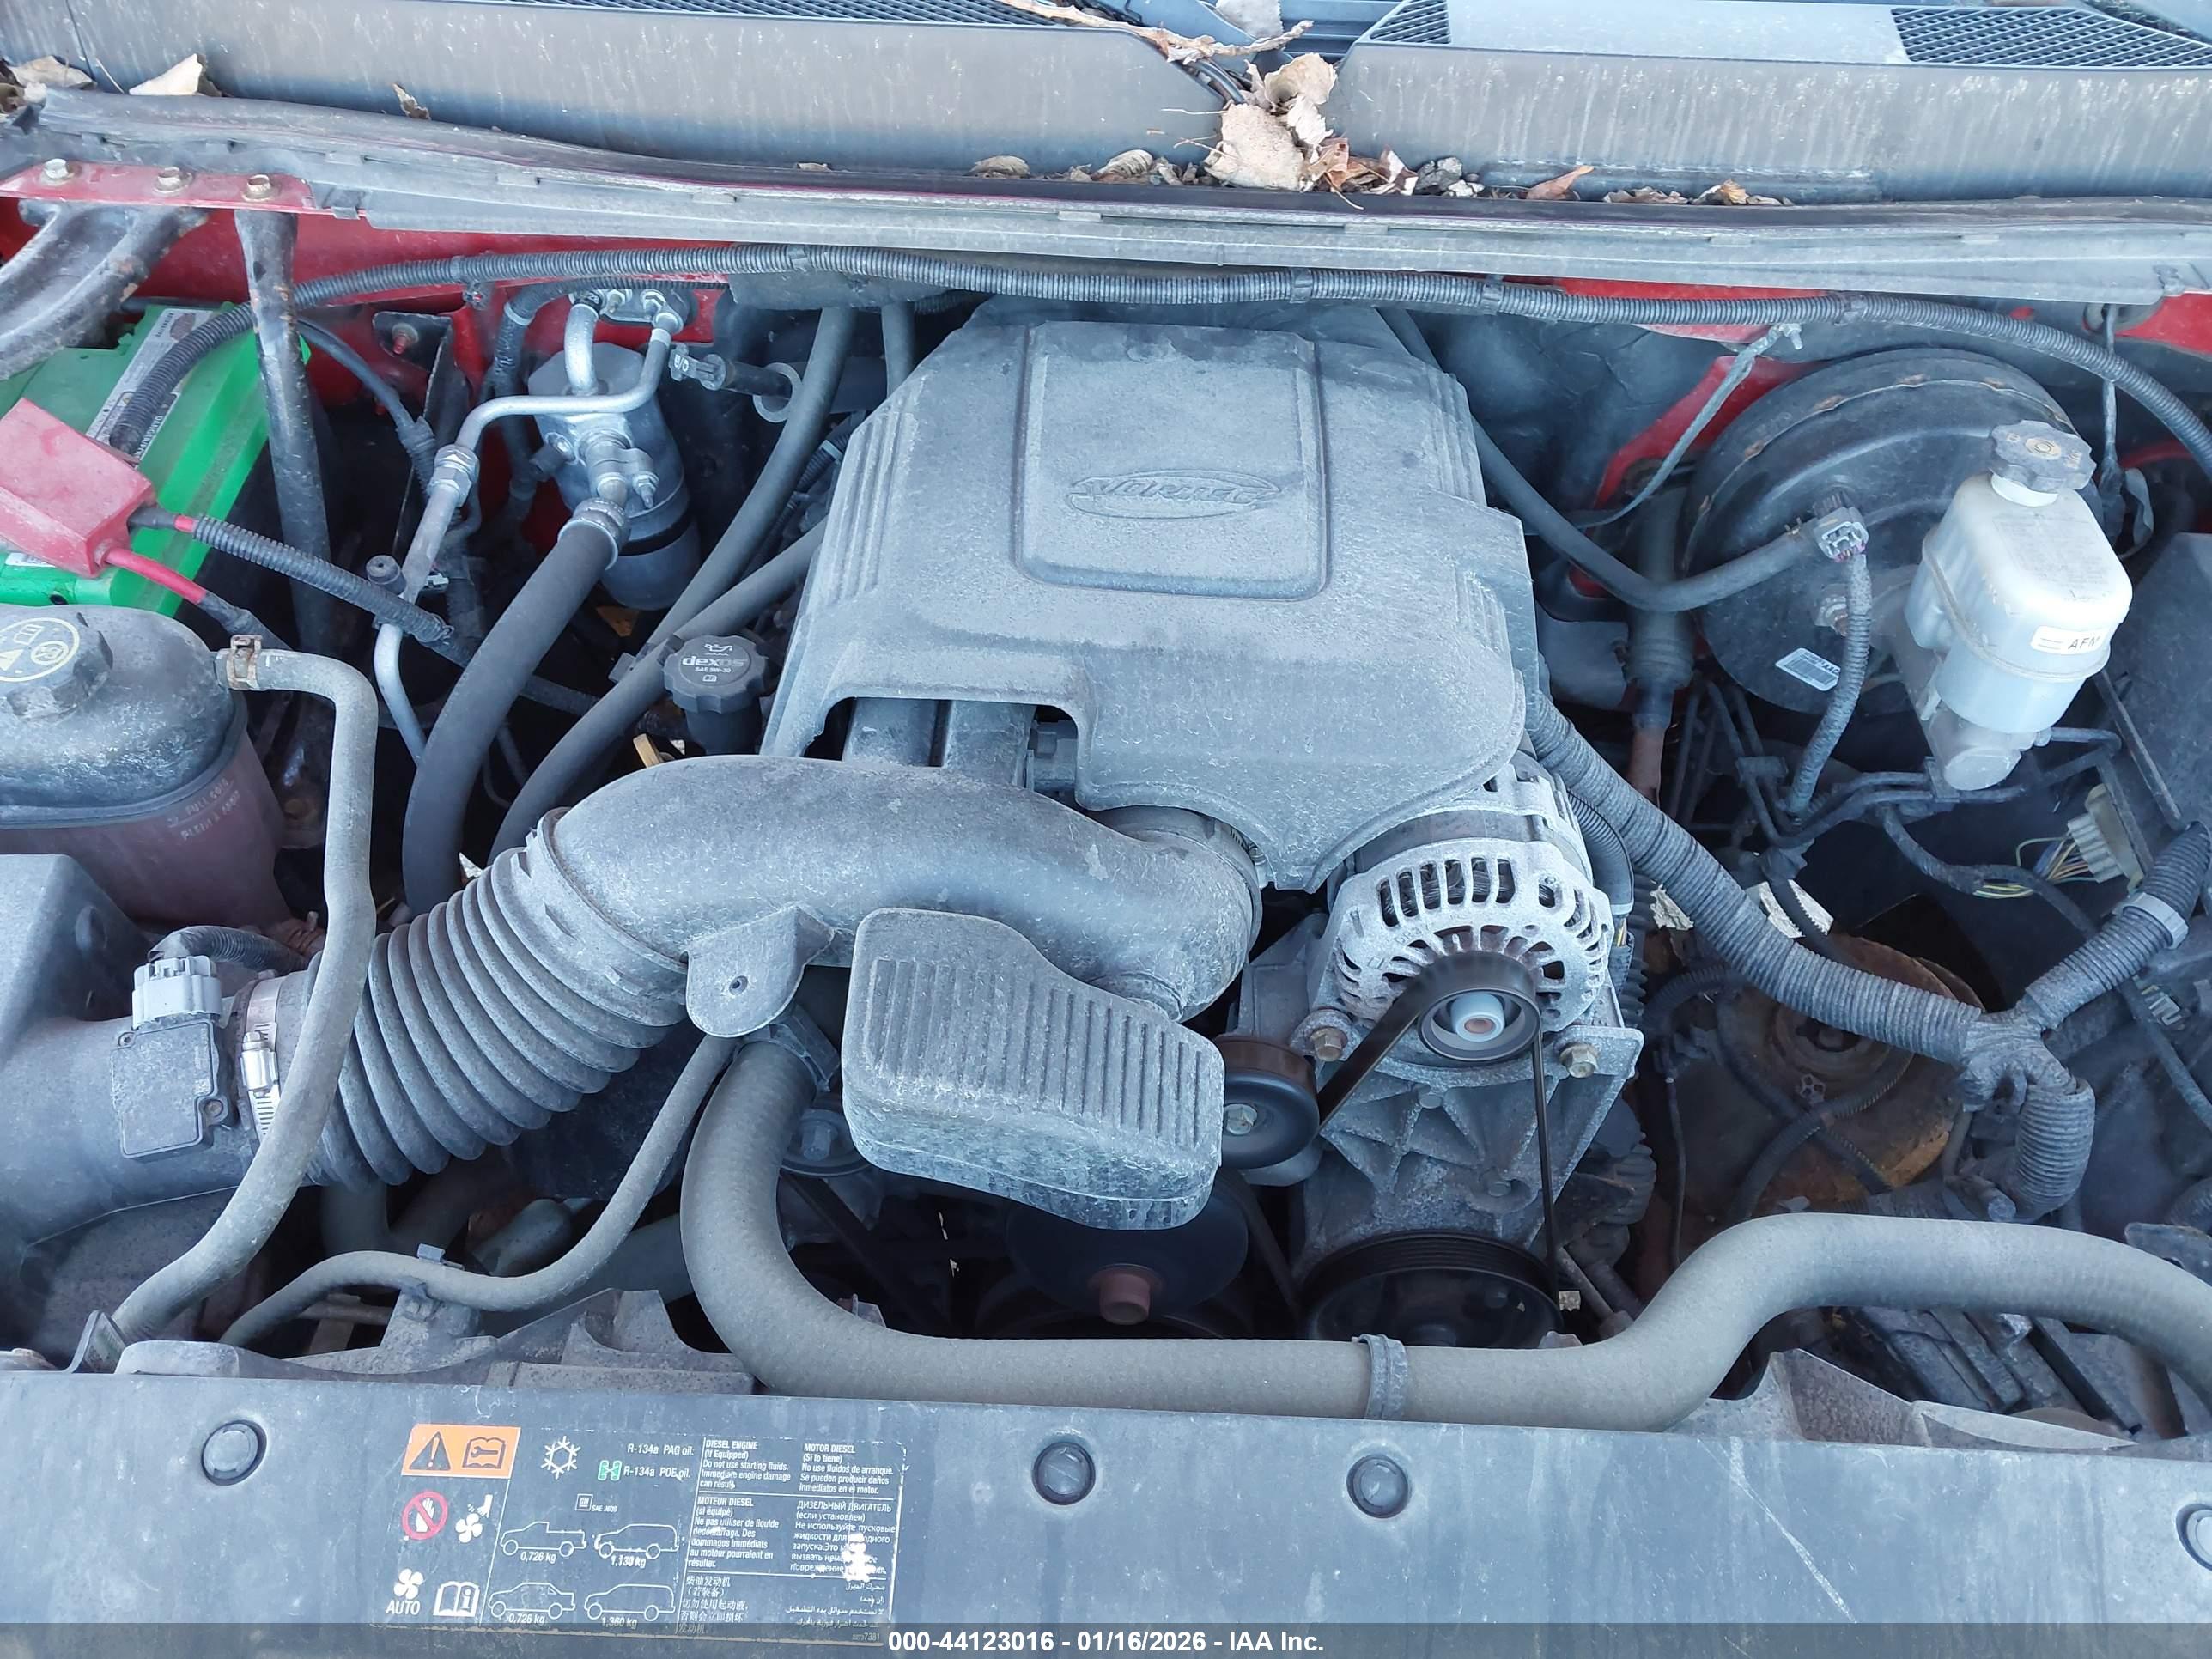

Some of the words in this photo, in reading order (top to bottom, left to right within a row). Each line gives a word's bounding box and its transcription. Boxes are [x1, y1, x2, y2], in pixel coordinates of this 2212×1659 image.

[682, 656, 748, 667] dexos
[627, 1443, 659, 1455] R-134a
[663, 1444, 681, 1455] PAG
[706, 1439, 730, 1449] DIESEL
[732, 1440, 758, 1449] ENGINE
[804, 1443, 830, 1453] MOTOR
[830, 1444, 855, 1453] DIESEL
[714, 1450, 749, 1460] Equipped)
[822, 1455, 842, 1463] tiene)
[702, 1459, 712, 1468] Do
[714, 1460, 725, 1468] not
[740, 1461, 767, 1471] starting
[768, 1462, 788, 1471] fluids.
[827, 1464, 850, 1473] fluidos
[851, 1465, 860, 1474] de
[623, 1465, 655, 1477] R-134a
[659, 1467, 677, 1478] POE
[738, 1472, 762, 1480] engine
[763, 1472, 791, 1482] damage
[811, 1474, 836, 1483] pueden
[837, 1474, 867, 1484] producir
[868, 1476, 889, 1485] daños
[857, 1486, 878, 1494] motor.
[697, 1496, 727, 1505] MOTEUR
[728, 1498, 754, 1506] DIESEL
[797, 1500, 846, 1510] ДИЗЕЛЬНЫЙ
[848, 1502, 891, 1512] ДВИГАТЕЛЬ
[706, 1507, 733, 1517] équipé)
[796, 1511, 817, 1520] (если
[818, 1512, 866, 1522] установлен)
[705, 1518, 719, 1527] pas
[720, 1517, 744, 1527] utiliser
[795, 1521, 805, 1529] Не
[742, 1528, 756, 1537] Des
[691, 1538, 730, 1548] dommages
[545, 1553, 556, 1564] kg
[726, 1550, 763, 1559] pourraient
[764, 1551, 774, 1559] en
[635, 1558, 646, 1568] kg
[386, 1600, 421, 1616] AUTO
[532, 1614, 545, 1625] kg
[625, 1617, 637, 1629] kg
